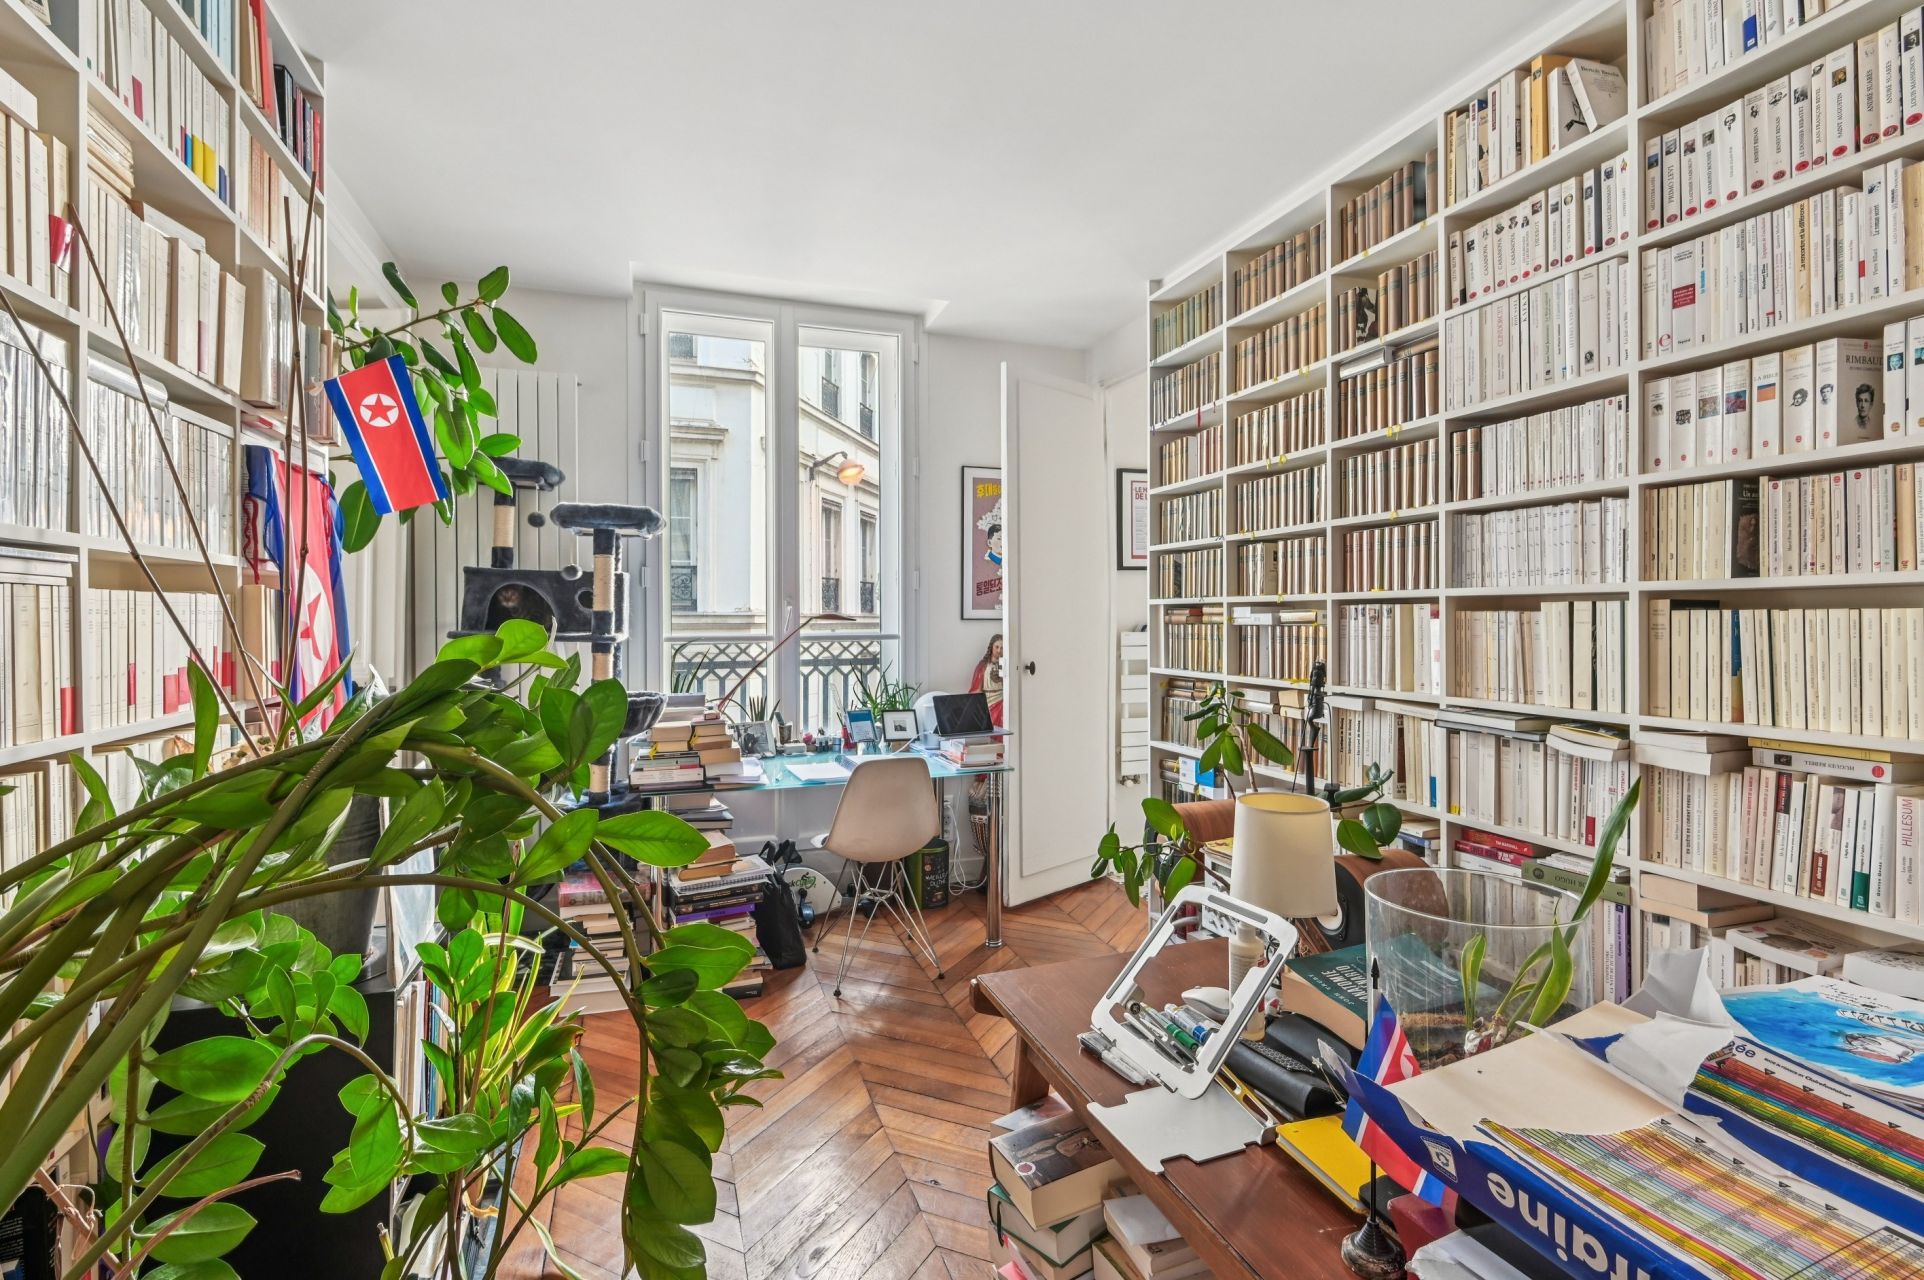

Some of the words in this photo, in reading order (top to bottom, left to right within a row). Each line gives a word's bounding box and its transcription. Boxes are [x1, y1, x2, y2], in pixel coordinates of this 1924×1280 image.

[1866, 92, 1874, 112] ANDRÉ
[1667, 164, 1675, 180] LEVI
[1667, 181, 1675, 203] PRIMO
[1828, 763, 1855, 772] HUGUES
[1901, 798, 1913, 847] HILLESUM
[1554, 876, 1576, 886] HUGO
